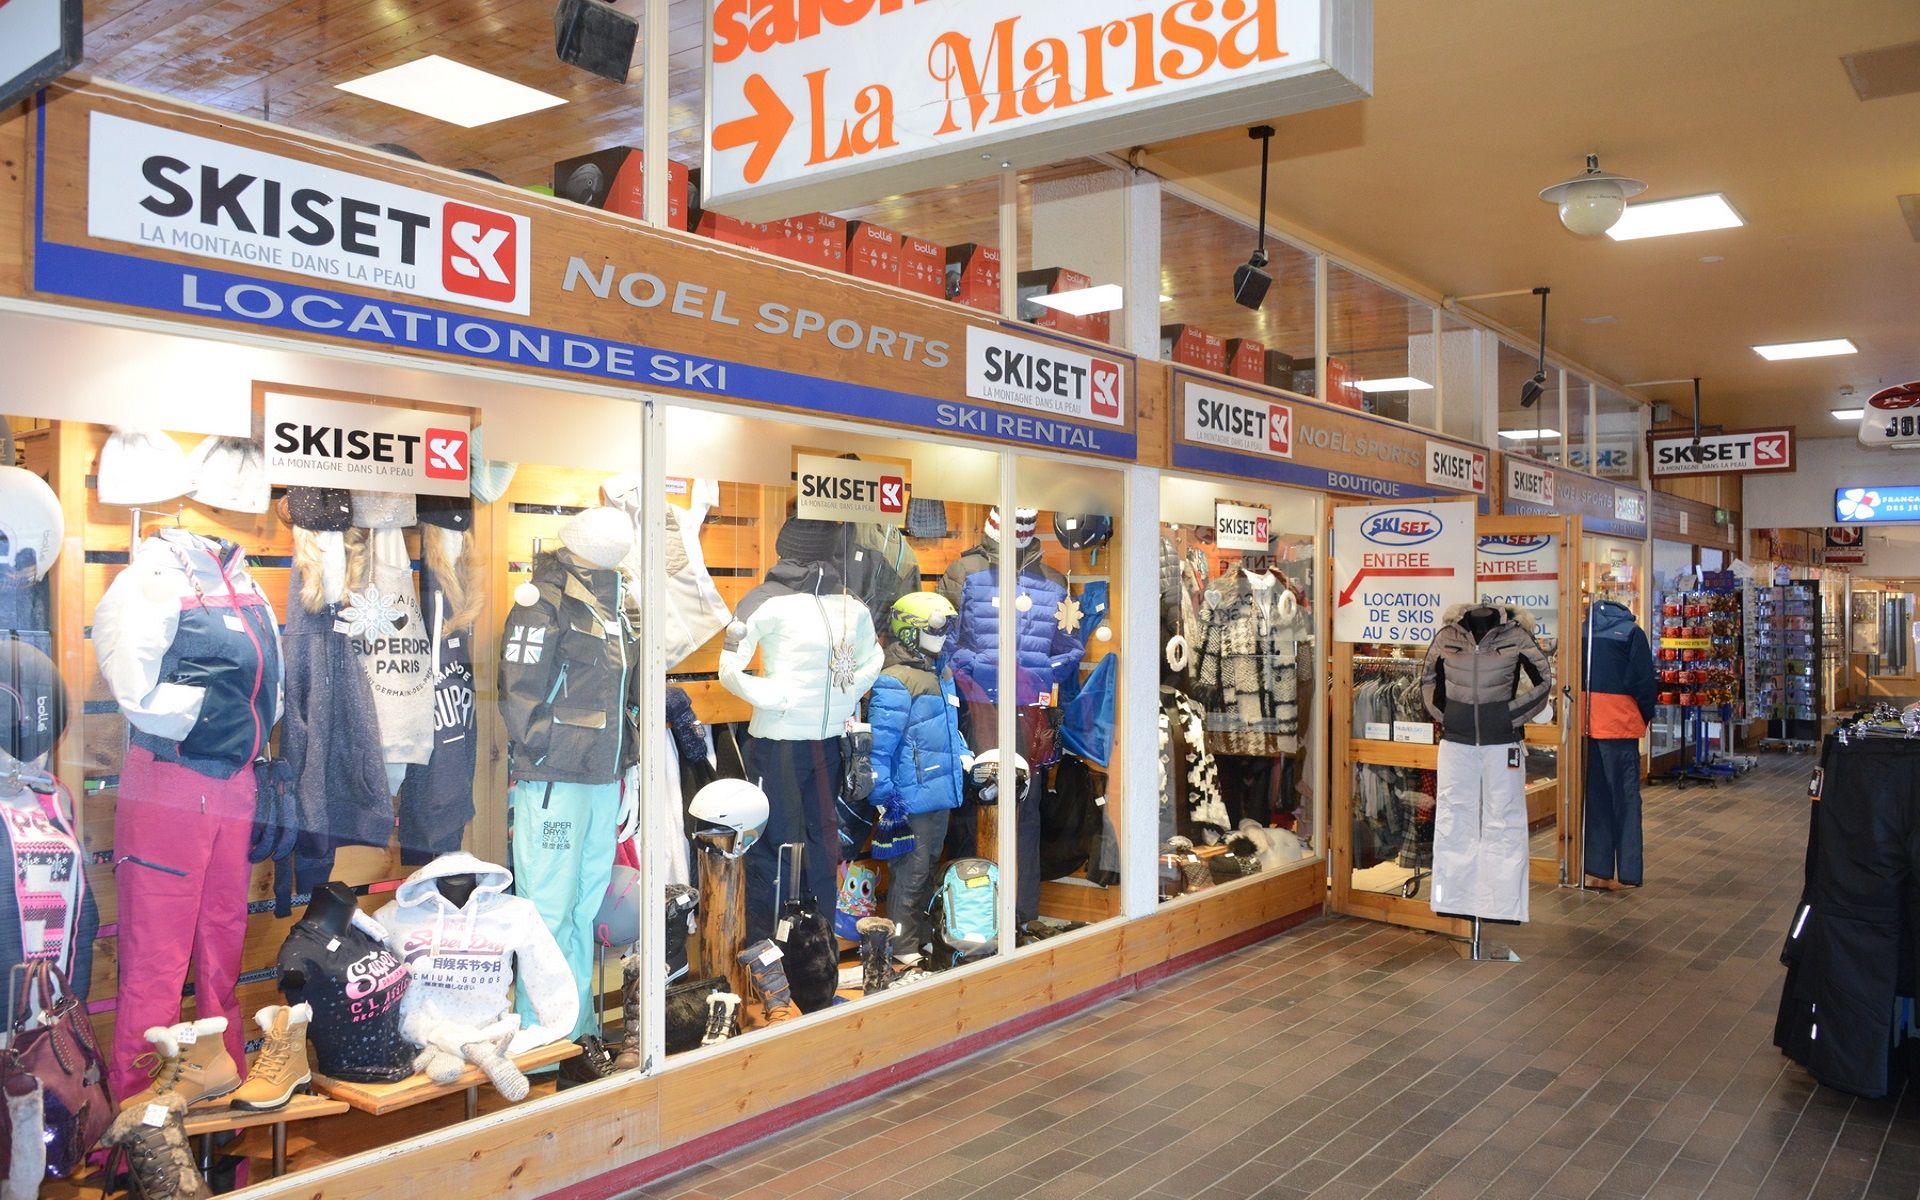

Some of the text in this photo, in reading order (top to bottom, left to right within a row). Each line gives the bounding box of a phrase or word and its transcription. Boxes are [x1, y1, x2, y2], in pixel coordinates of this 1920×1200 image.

[803, 0, 1289, 168] La Marisa
[139, 154, 431, 267] SKISET
[867, 226, 893, 243] bollé
[139, 222, 416, 291] LA MONTAGNE DANS LA PEAU
[913, 241, 938, 257] bollé
[561, 255, 950, 369] NOEL SPORTS
[182, 273, 727, 391] LOCATION DE SKI
[983, 346, 1087, 400] SKISET
[982, 385, 1081, 415] LA MONTAGNE DANS LA PEAU
[935, 402, 1101, 450] SKI RENTAL
[1197, 398, 1267, 439] SKISET
[1885, 415, 1920, 438] JO
[273, 421, 421, 465] SKISET
[1297, 424, 1421, 468] NOEL SPORTS
[1658, 441, 1752, 465] SKSET
[271, 457, 415, 478] LA MONTAGNE DANS LA PEAU
[1433, 451, 1472, 480] SKISET
[801, 474, 879, 503] SKISET
[1327, 471, 1401, 497] BOUTIQUE
[1514, 470, 1543, 494] SKISET
[800, 499, 808, 507] LA
[1885, 504, 1905, 512] DES
[1219, 518, 1255, 536] SKISET
[1372, 516, 1431, 535] SKISET
[1363, 552, 1430, 568] ENTREE
[1363, 592, 1440, 607] LOCATION
[1369, 609, 1434, 624] DE SKIS
[1362, 626, 1382, 640] AU
[376, 659, 420, 674] PARIS
[36, 695, 48, 733] bollé
[543, 821, 572, 829] SUPER
[543, 828, 561, 836] DRY
